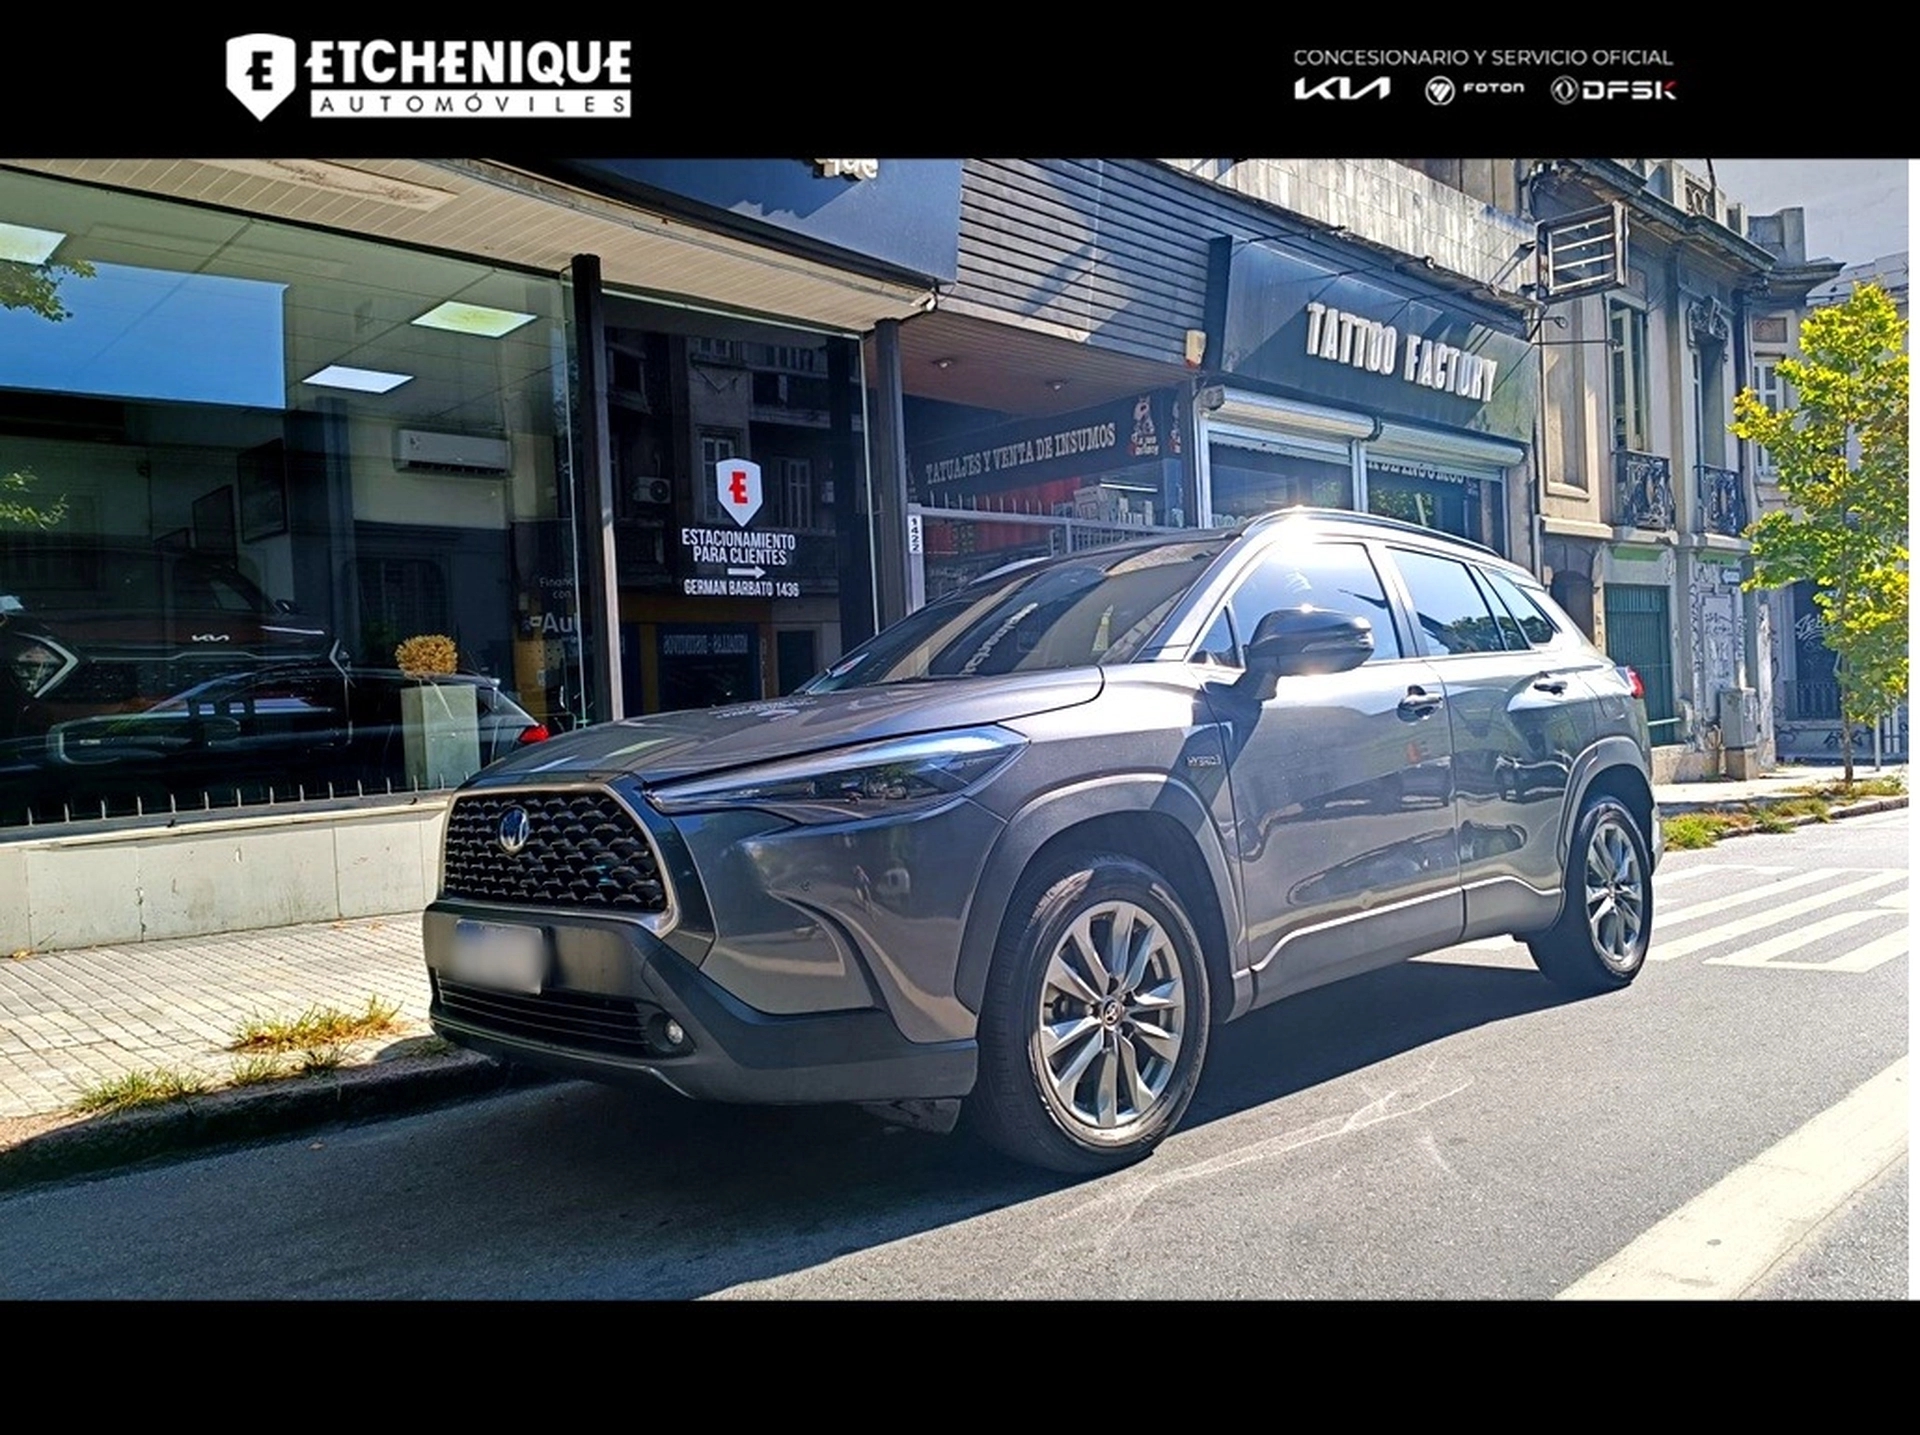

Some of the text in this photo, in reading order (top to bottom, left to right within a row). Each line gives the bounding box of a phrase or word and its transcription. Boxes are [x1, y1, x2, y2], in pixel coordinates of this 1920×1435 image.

[1306, 302, 1497, 402] TATTOO FACTORY
[925, 453, 983, 484] TATUAJES
[982, 450, 992, 473] Y
[993, 441, 1034, 470] VENTA
[1035, 435, 1053, 461] DE
[1053, 422, 1116, 457] INSUMOS
[681, 528, 796, 550] ESTACIONAMIENTO
[910, 517, 920, 552] 1422
[693, 546, 787, 565] PARA CLIENTES
[683, 579, 728, 596] GERMAN
[728, 580, 774, 597] BARBATO
